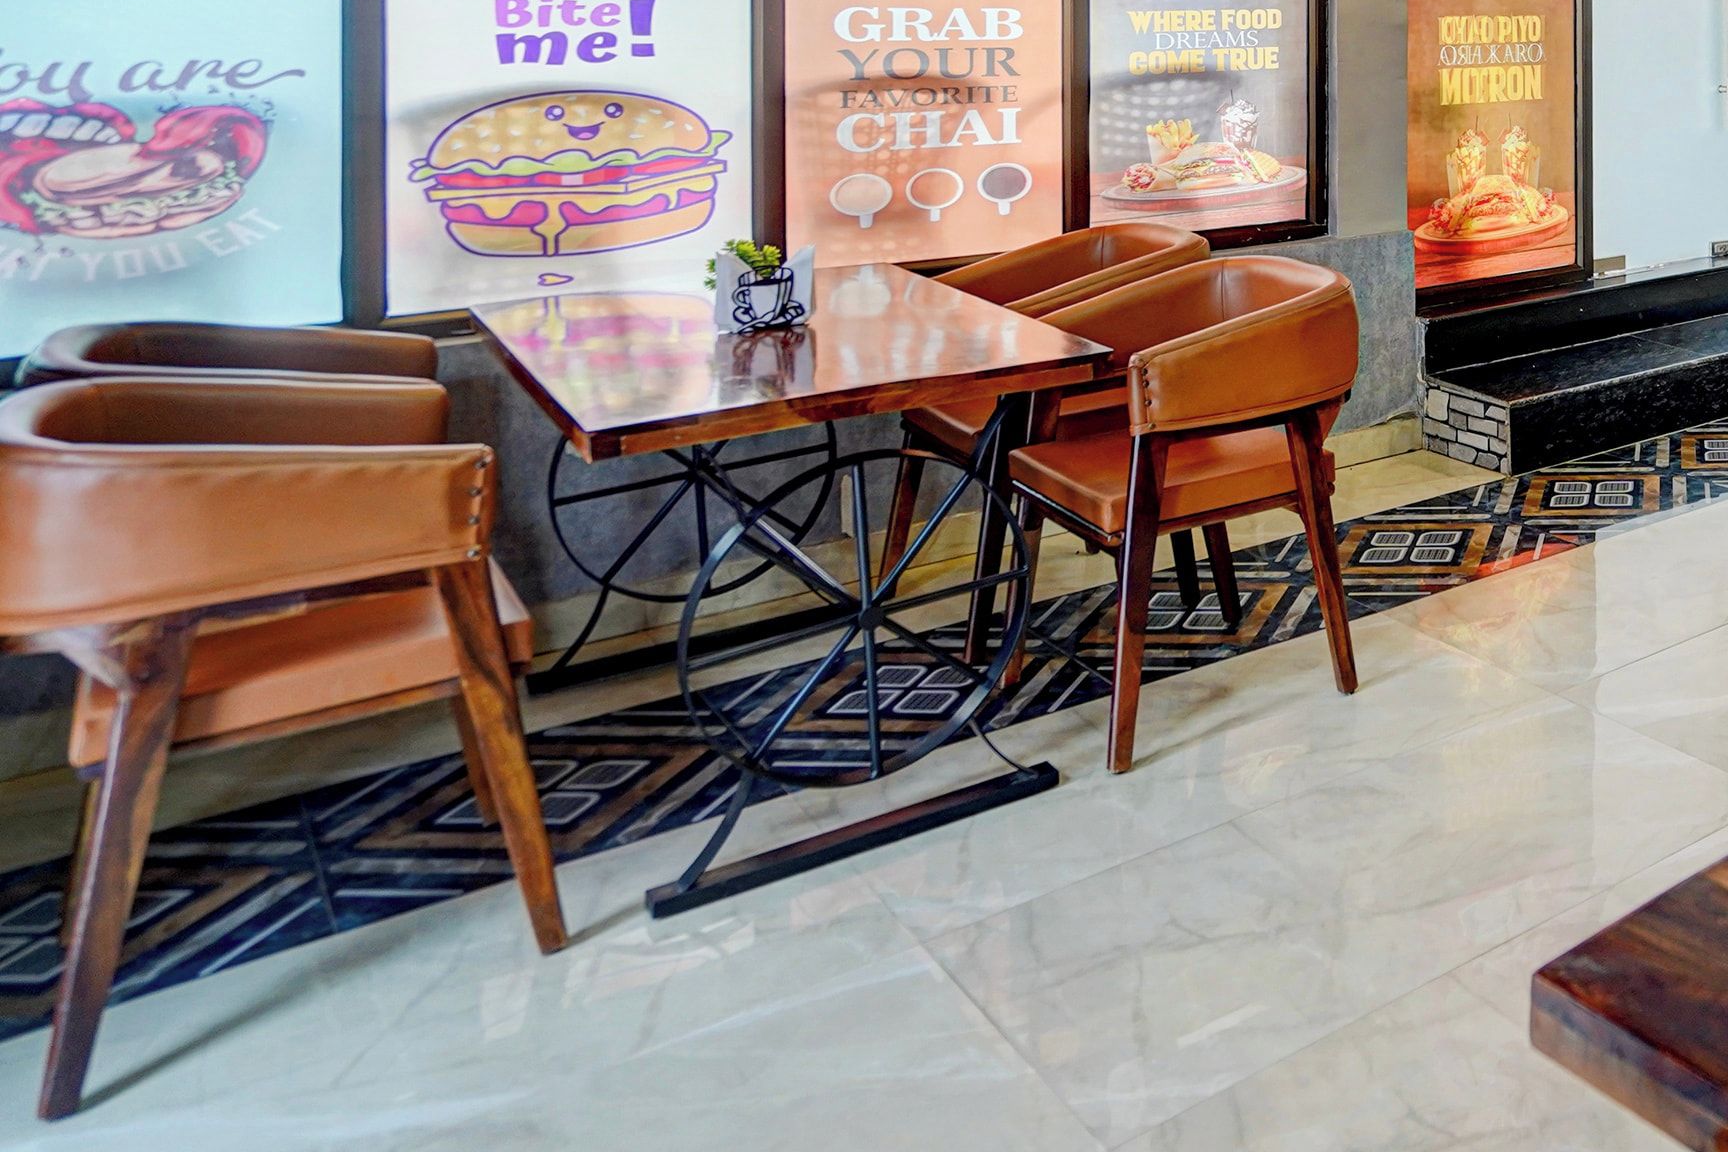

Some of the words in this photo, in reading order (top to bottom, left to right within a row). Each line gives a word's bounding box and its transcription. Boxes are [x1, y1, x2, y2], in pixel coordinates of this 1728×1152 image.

[833, 6, 1024, 43] GRAB
[1126, 8, 1216, 36] WHERE
[1220, 8, 1283, 32] FOOD
[1155, 30, 1260, 51] DREAMS
[837, 46, 1021, 81] YOUR
[1128, 49, 1207, 76] COME
[1212, 46, 1280, 72] TRUE
[0, 60, 94, 104] ou
[119, 57, 306, 93] are
[839, 84, 1019, 109] FAVORITE
[836, 107, 1022, 153] CHAI
[195, 206, 284, 259] EAT
